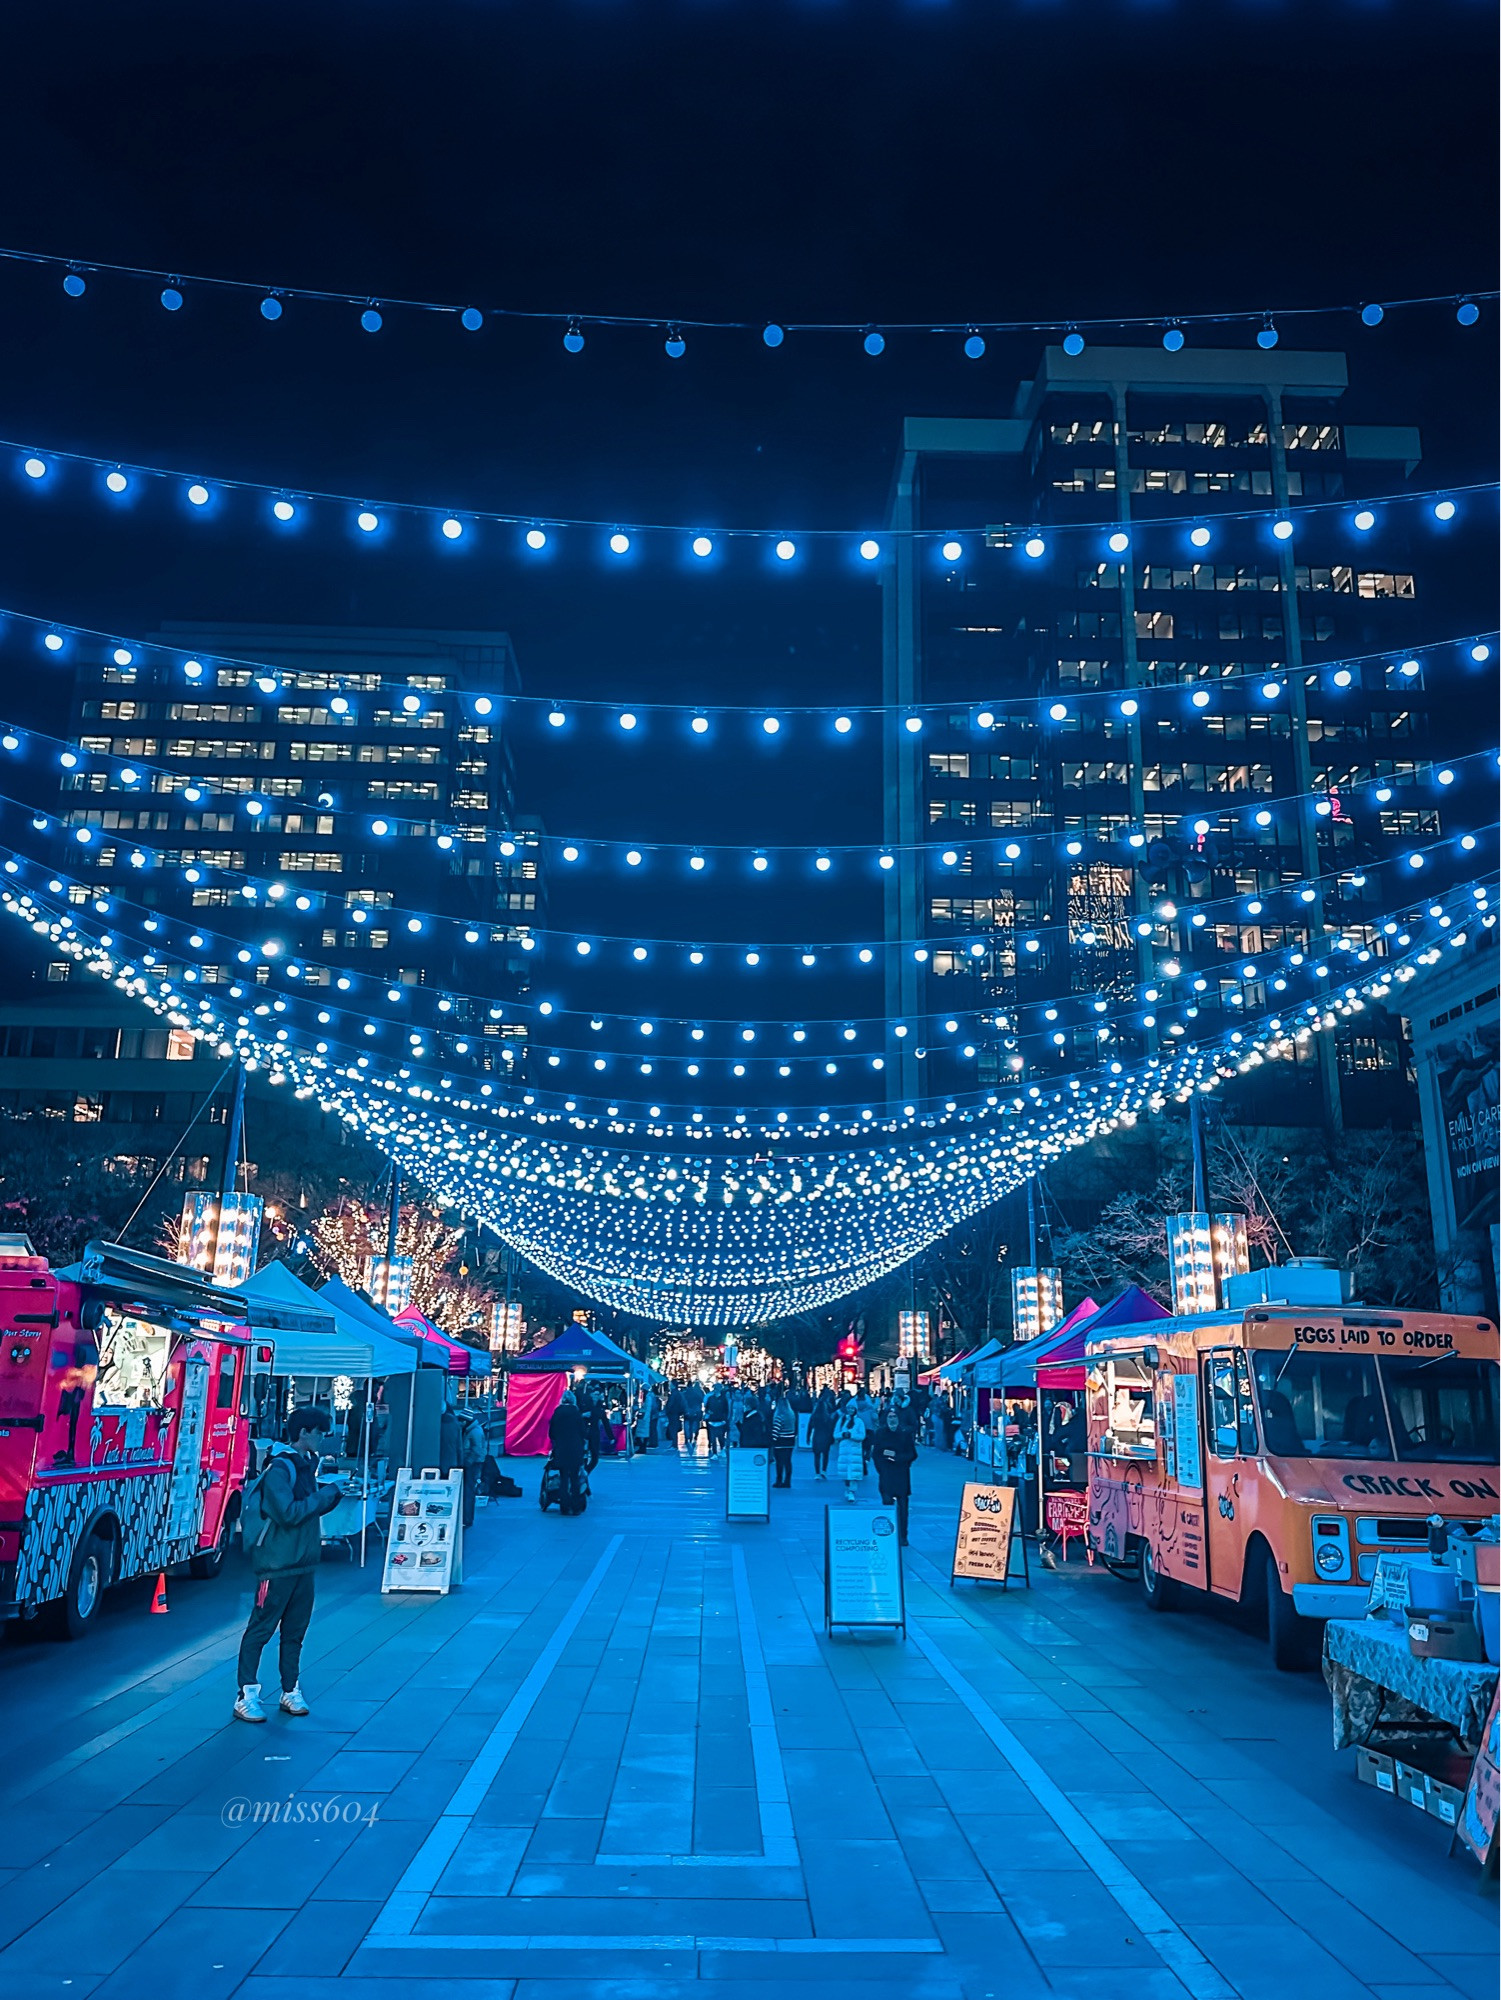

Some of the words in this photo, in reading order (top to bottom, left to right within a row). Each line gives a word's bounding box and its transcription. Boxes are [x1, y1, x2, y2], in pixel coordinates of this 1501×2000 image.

[1448, 1113, 1476, 1136] EMILY
[1457, 1164, 1471, 1178] NOW
[1472, 1160, 1481, 1173] ON
[1482, 1154, 1499, 1170] VIEW
[1294, 1327, 1335, 1344] EGGS
[1341, 1330, 1370, 1344] LAID
[1377, 1331, 1395, 1346] TO
[1403, 1331, 1453, 1349] ORDER
[1343, 1475, 1445, 1498] CRACK
[1449, 1478, 1500, 1499] ON
